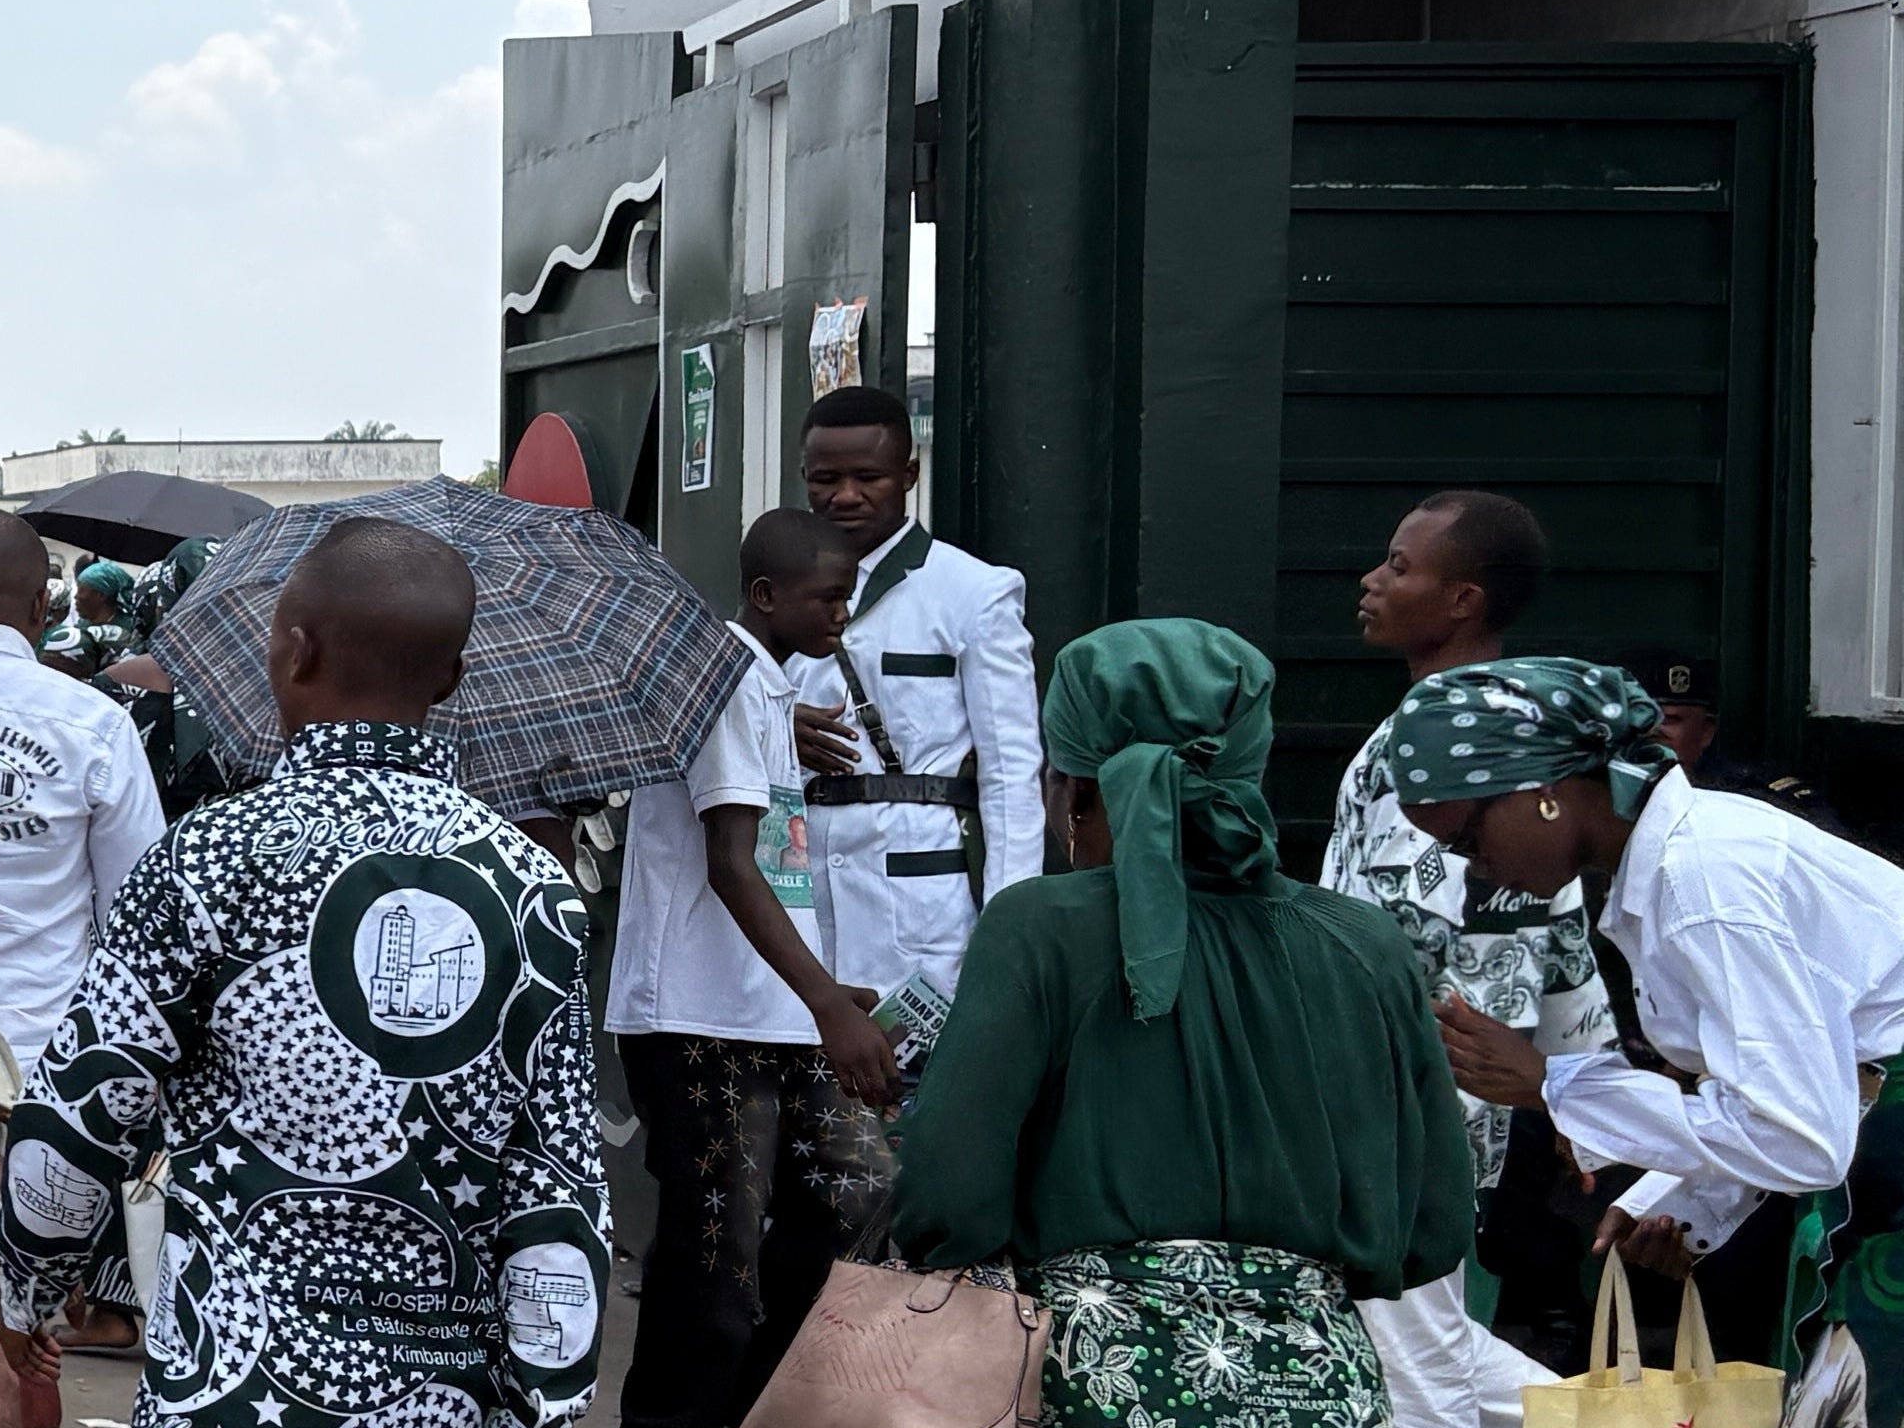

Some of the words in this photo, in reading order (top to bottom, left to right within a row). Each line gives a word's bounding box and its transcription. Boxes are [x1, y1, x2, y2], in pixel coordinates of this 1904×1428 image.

[255, 796, 462, 877] Special
[142, 887, 181, 941] PAPA
[304, 1284, 365, 1305] PAPA
[371, 1291, 447, 1314] JOSEPH
[342, 1314, 369, 1333] Le
